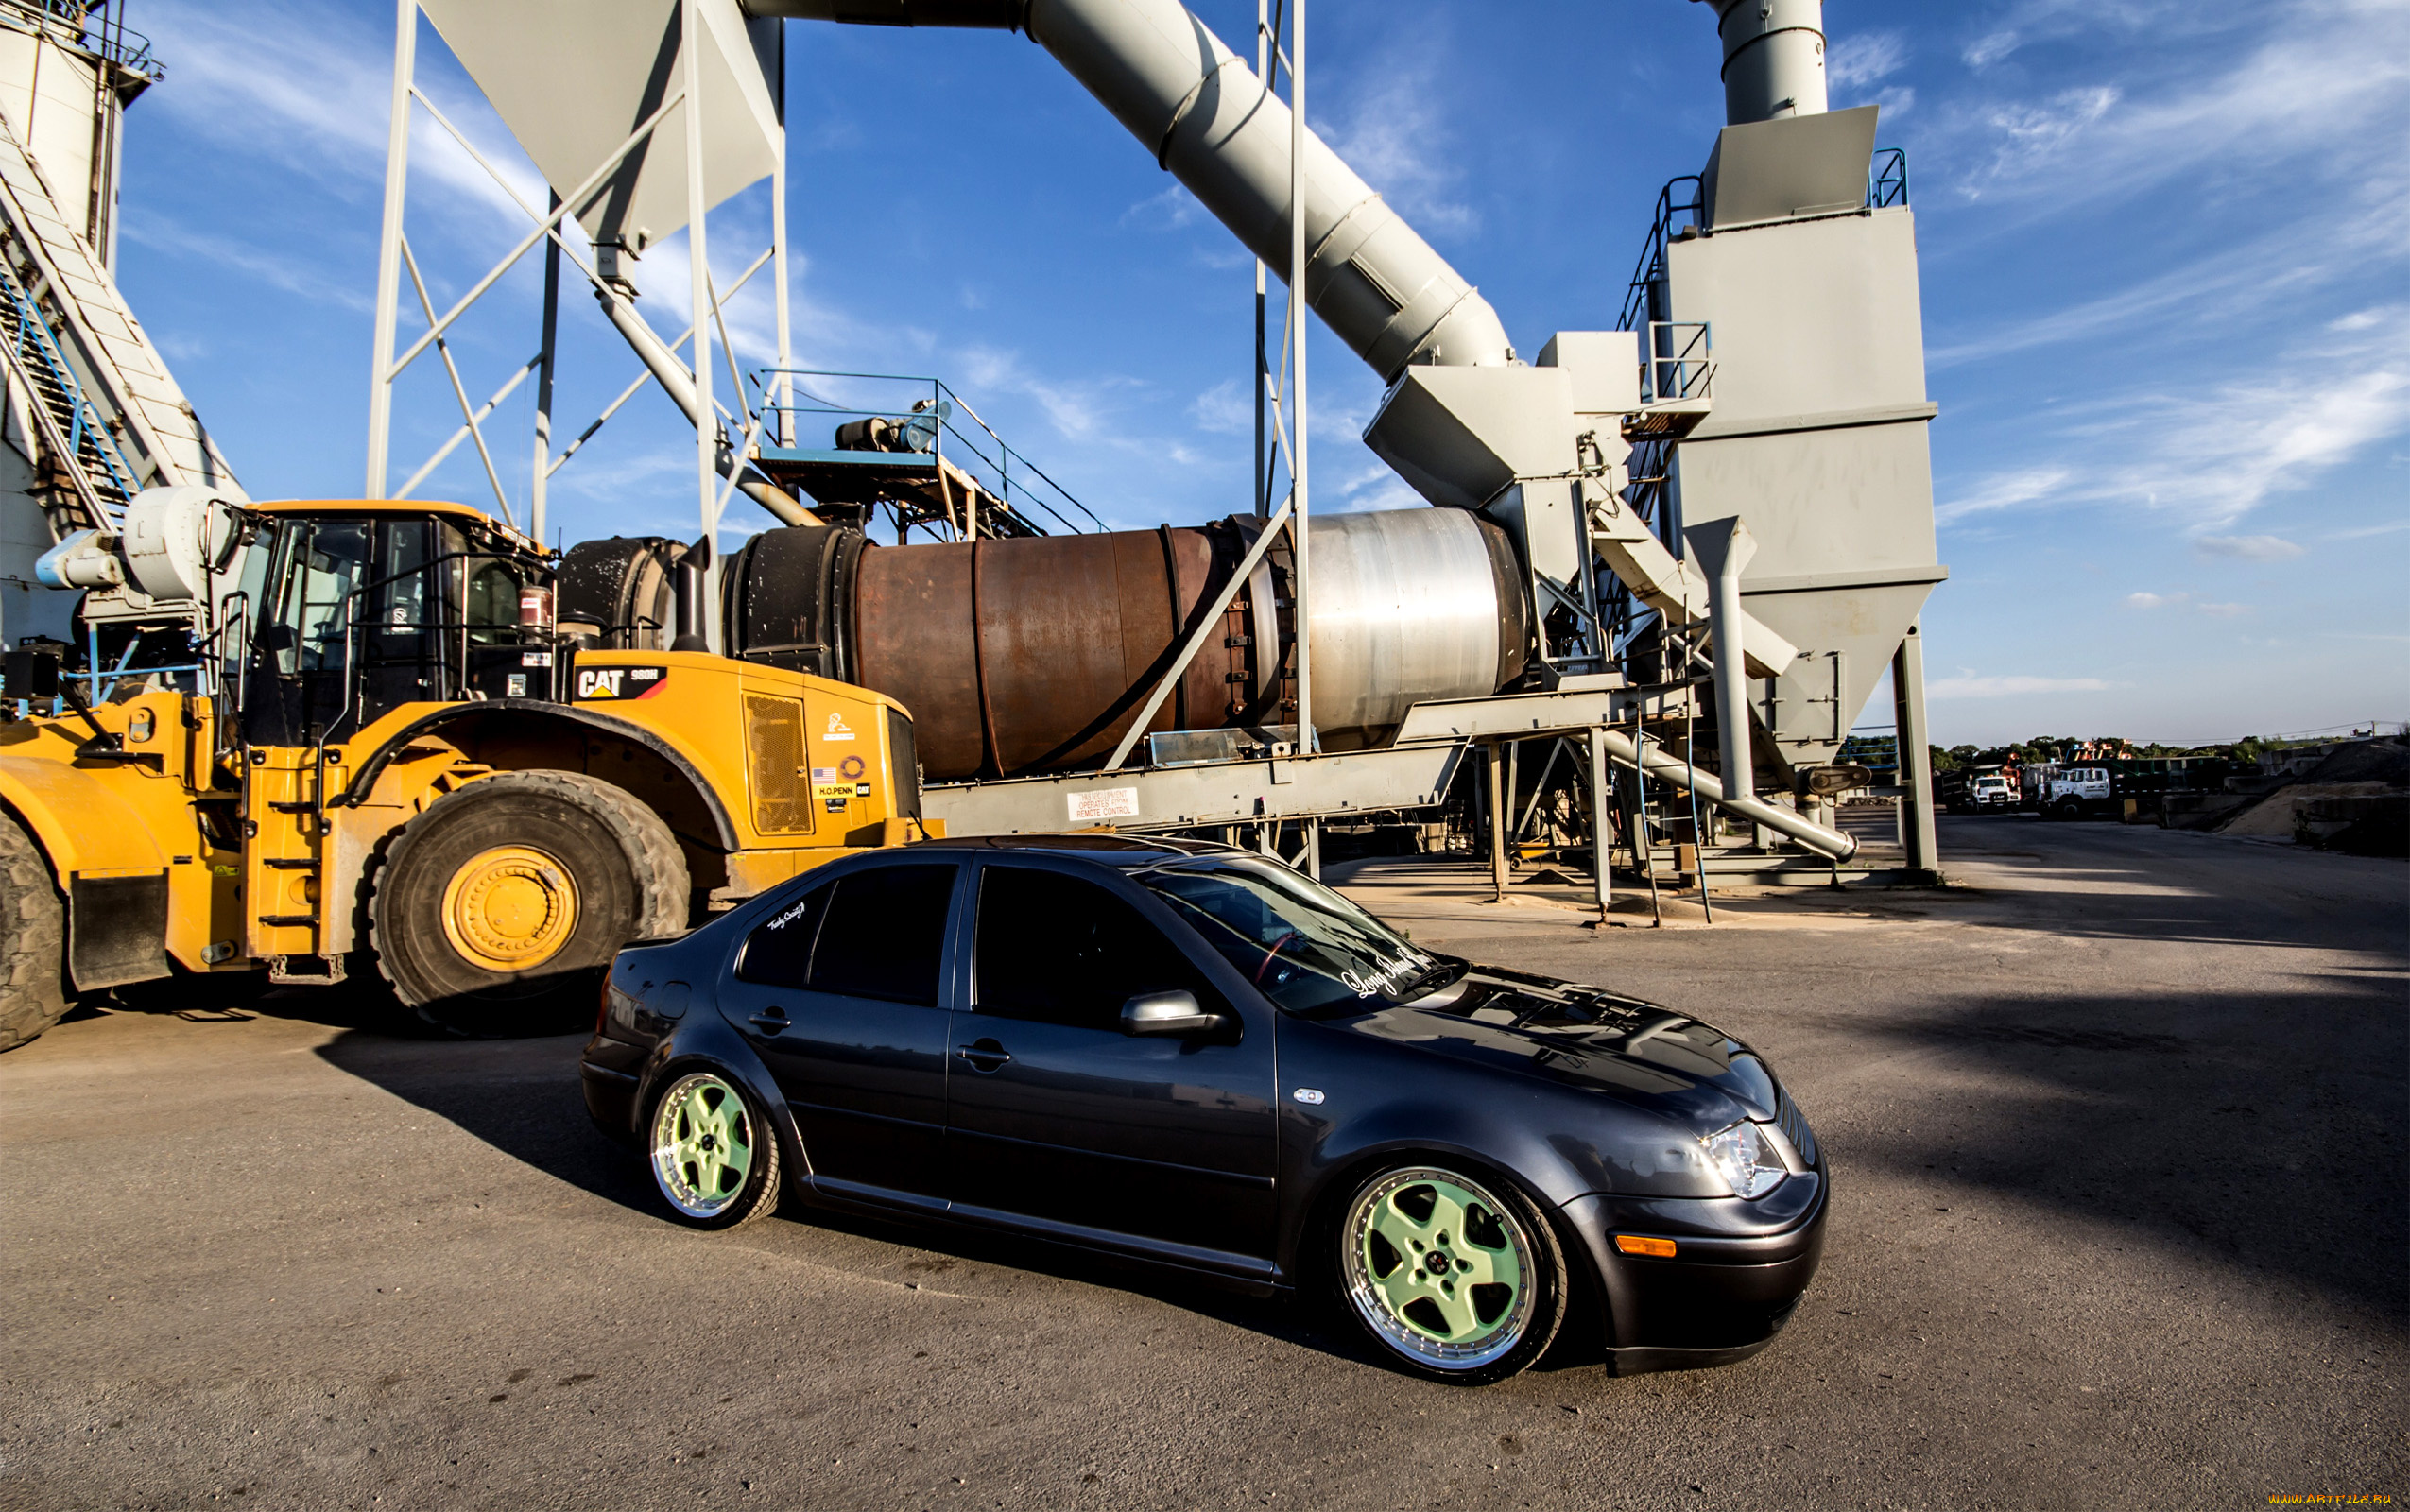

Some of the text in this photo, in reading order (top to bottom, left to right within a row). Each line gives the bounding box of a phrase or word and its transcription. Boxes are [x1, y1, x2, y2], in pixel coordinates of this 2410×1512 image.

[578, 669, 659, 698] CAT 980H
[856, 785, 870, 795] CAT
[1078, 799, 1110, 810] OPERATES
[1076, 805, 1131, 818] REMOTE CONTROL
[1340, 968, 1398, 999] Long
